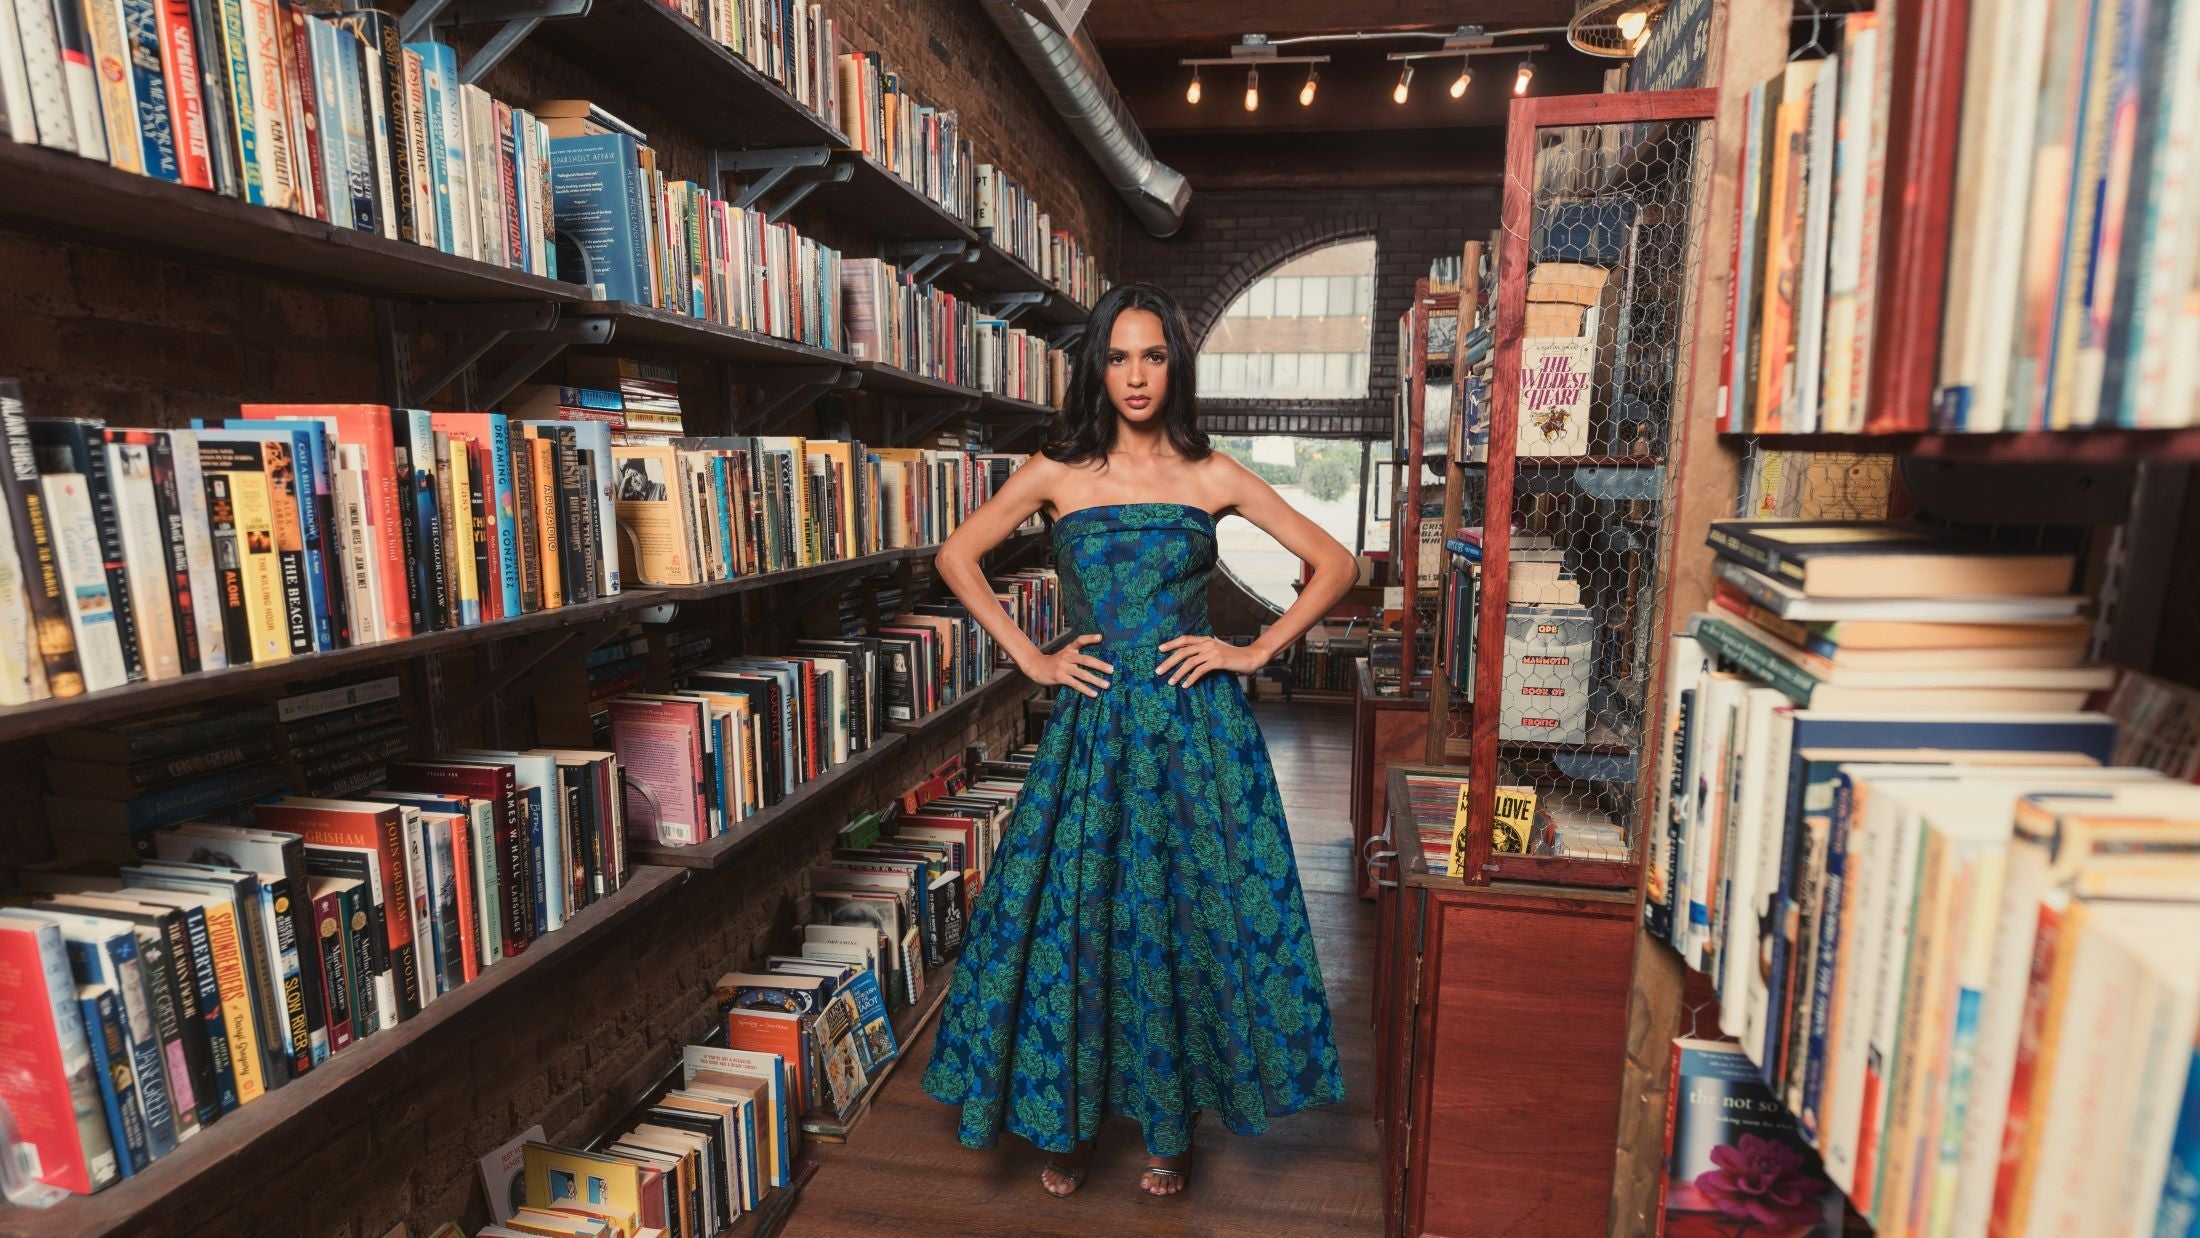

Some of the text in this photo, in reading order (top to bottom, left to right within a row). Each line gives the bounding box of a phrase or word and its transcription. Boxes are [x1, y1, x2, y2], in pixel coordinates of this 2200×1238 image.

[384, 25, 396, 67] FORSYTH
[405, 53, 422, 103] Forsyth
[139, 102, 155, 139] DAY
[149, 75, 176, 173] MEMORIAL
[412, 105, 427, 173] Alternative
[527, 120, 536, 161] Michael
[270, 119, 290, 187] KEN FOLLETT
[348, 141, 364, 197] FORD
[391, 82, 413, 213] FOURTH PROTOCOL
[553, 152, 614, 164] SPARSHOLT AFFAIR
[502, 156, 522, 259] CORRECTIONS
[533, 200, 542, 245] Headlong
[629, 195, 643, 268] HOLLINGHURST
[1521, 369, 1589, 390] WILDEST
[1539, 357, 1572, 372] THE
[1, 398, 29, 435] ALAN
[1524, 389, 1579, 410] HEART
[298, 443, 306, 465] CAST
[417, 417, 428, 461] GIMENEZ
[494, 424, 507, 485] DREAMING
[560, 431, 580, 489] SCHISM
[302, 475, 310, 494] BLUE
[460, 482, 470, 513] Easy
[782, 458, 790, 493] YOU
[275, 501, 286, 546] GARLAND
[284, 501, 292, 525] ALEX
[304, 497, 316, 535] SHADOW
[382, 477, 397, 561] the lies that bind
[403, 518, 414, 555] Golden
[516, 453, 535, 589] NADINE GORDIMER
[543, 485, 557, 551] ARCADIO
[569, 496, 582, 553] Bill Granger
[26, 495, 60, 598] MISSION TO PARIS
[349, 503, 367, 589] FUNERAL RITES JEAN GENET
[431, 516, 445, 606] THE COLOR OF LAW
[502, 530, 514, 588] GONZALEZ
[582, 497, 593, 582] THE TIN DRUM
[226, 572, 240, 608] ALONE
[258, 558, 274, 631] THE KILLING HOUR
[283, 555, 304, 634] THE BEACH
[1522, 657, 1569, 666] MAMMOTH
[769, 686, 780, 739] KOONTZ
[1522, 688, 1566, 696] BOOK OF
[1521, 718, 1560, 727] EROTICA
[1675, 703, 1687, 754] EARTHA
[530, 804, 541, 833] Boone
[1495, 797, 1532, 821] LOVE
[1654, 787, 1662, 813] END
[305, 831, 365, 845] GRISHAM
[506, 783, 516, 824] JAMES
[511, 845, 520, 878] HALL
[385, 821, 406, 921] JOHN GRISHAM
[1647, 842, 1658, 885] WORLD
[276, 916, 287, 951] GRIFFITH
[284, 915, 293, 944] NICOLA
[511, 885, 521, 933] LANGUAGE
[187, 914, 216, 998] LIBERTIE
[208, 912, 245, 1003] SPOONBENDERS
[325, 955, 333, 968] The
[352, 934, 361, 945] The
[168, 922, 183, 942] THE
[179, 983, 196, 1020] FACTOR
[332, 944, 346, 1010] Martha Grimes
[361, 938, 373, 1001] Martha Grimes
[401, 948, 416, 1002] SOOLEY
[151, 965, 178, 1038] JANE GREEN
[285, 977, 307, 1051] SLOW RIVER
[859, 996, 878, 1012] TAROT
[219, 1037, 229, 1066] KAITLYN
[233, 1014, 251, 1076] Daryl Gregory
[135, 1048, 169, 1128] JANE GREEN
[1690, 1089, 1778, 1112] the not so
